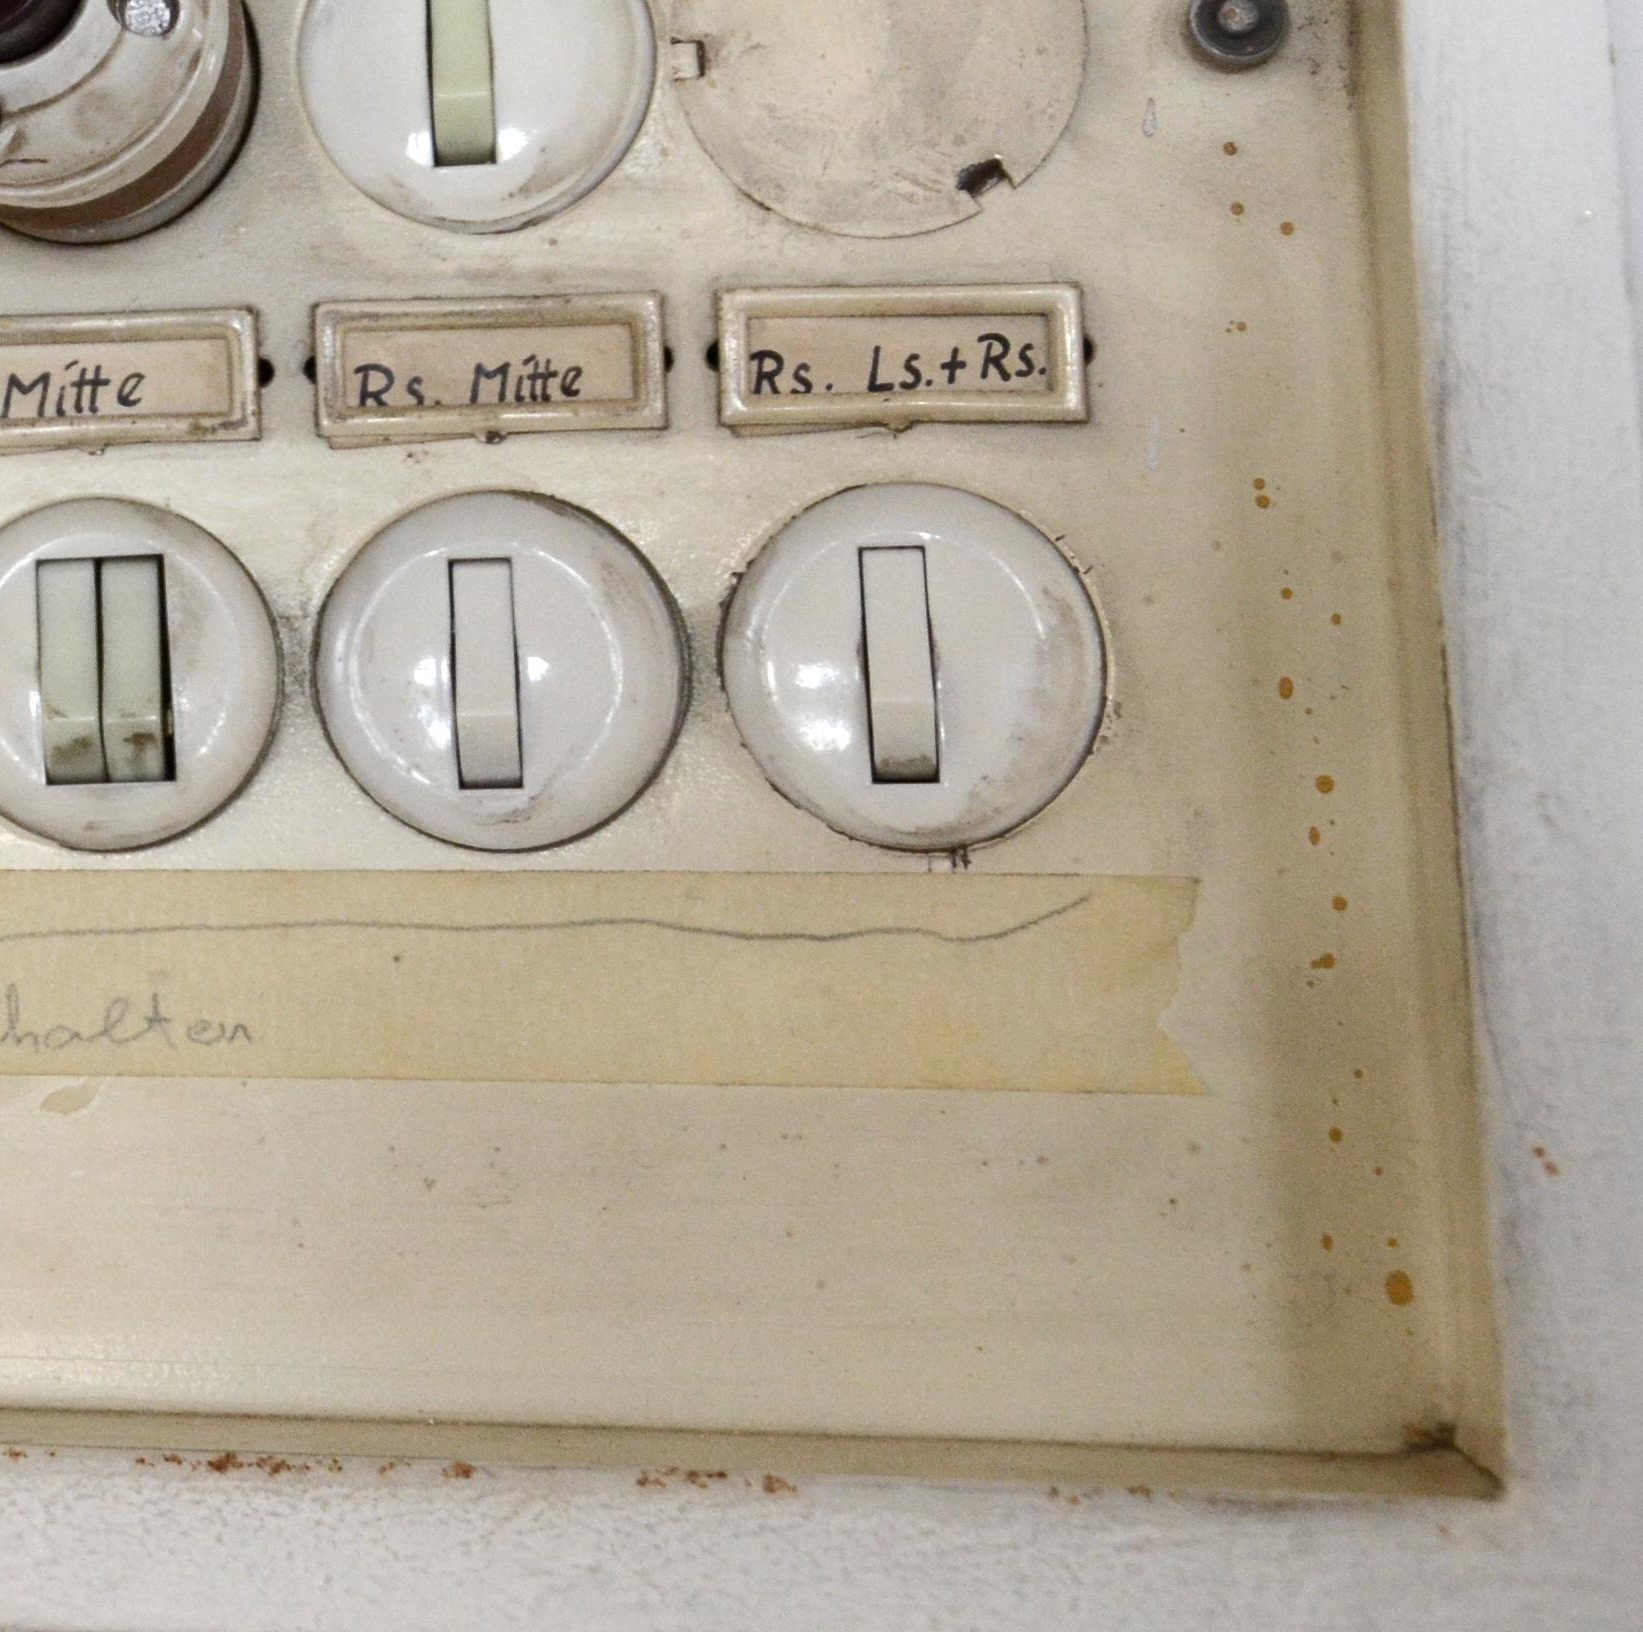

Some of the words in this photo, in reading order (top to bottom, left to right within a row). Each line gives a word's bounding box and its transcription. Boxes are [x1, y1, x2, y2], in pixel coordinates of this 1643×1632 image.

[0, 360, 145, 419] Mitte
[353, 363, 443, 408] Rs.
[469, 353, 583, 408] Mitte
[748, 348, 834, 396] Rs.
